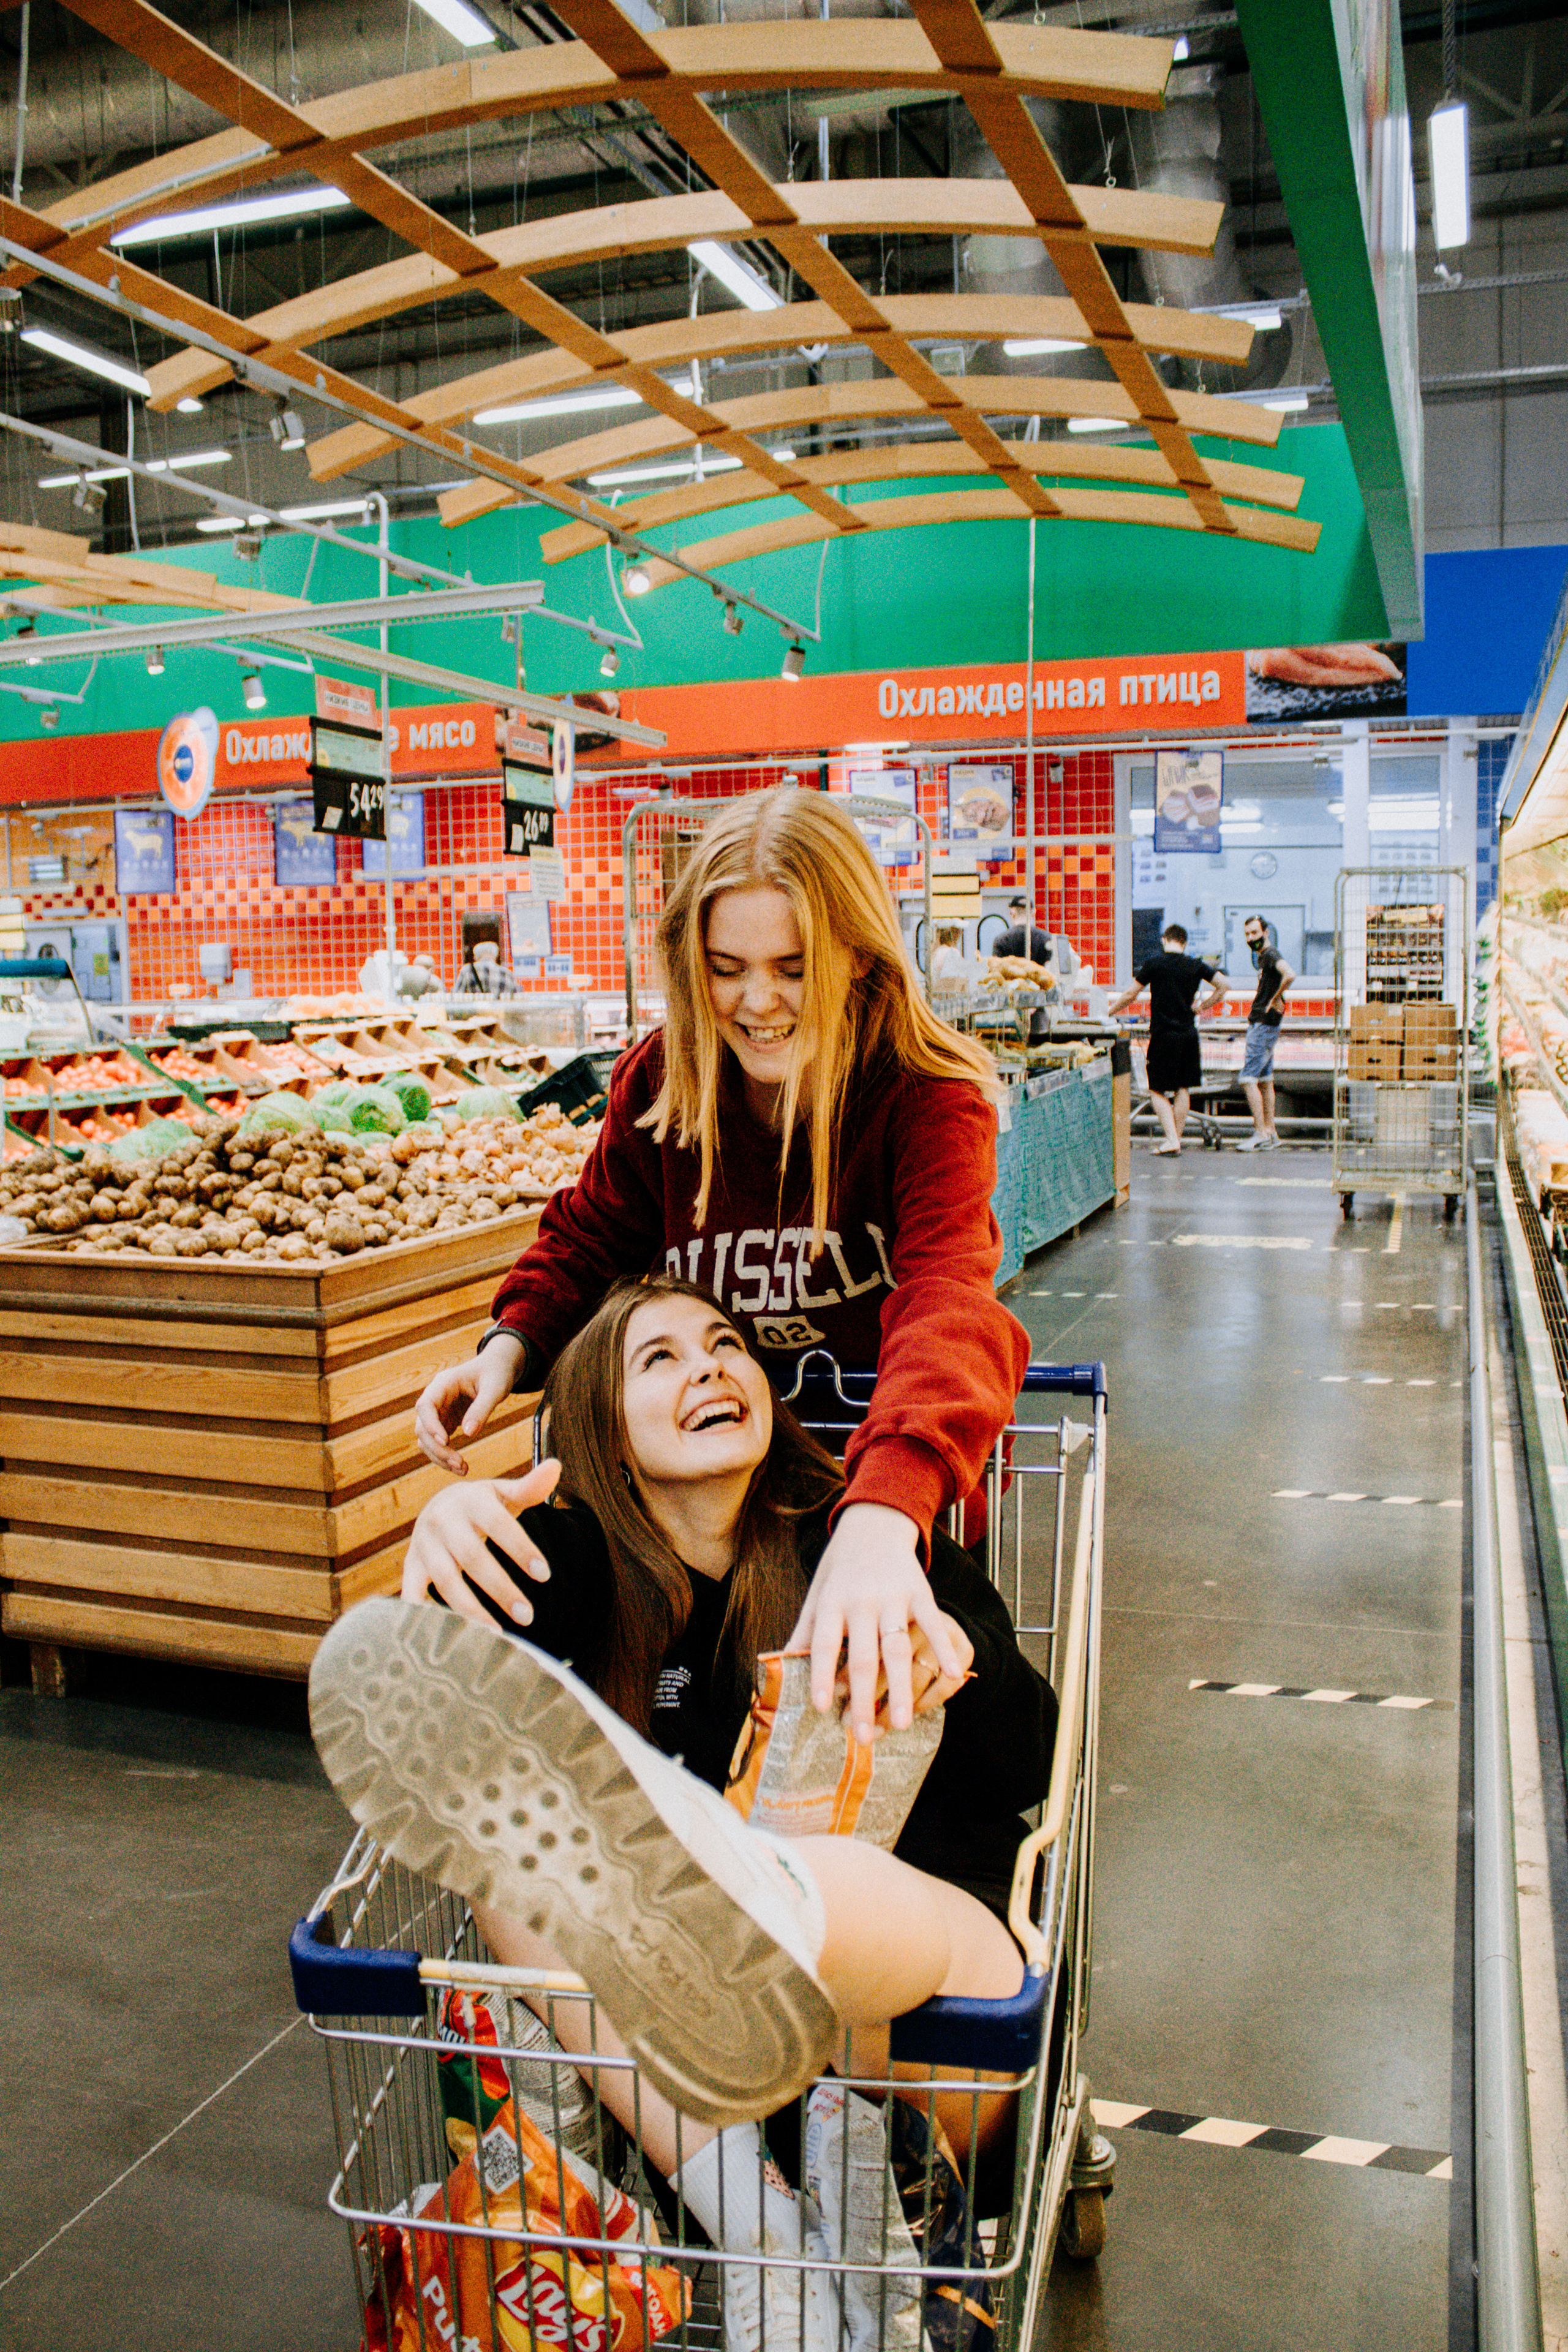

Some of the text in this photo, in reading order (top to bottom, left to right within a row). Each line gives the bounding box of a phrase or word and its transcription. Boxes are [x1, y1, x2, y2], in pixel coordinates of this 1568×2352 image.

[878, 670, 1221, 719] Охлажденная птица
[409, 720, 476, 750] мясо
